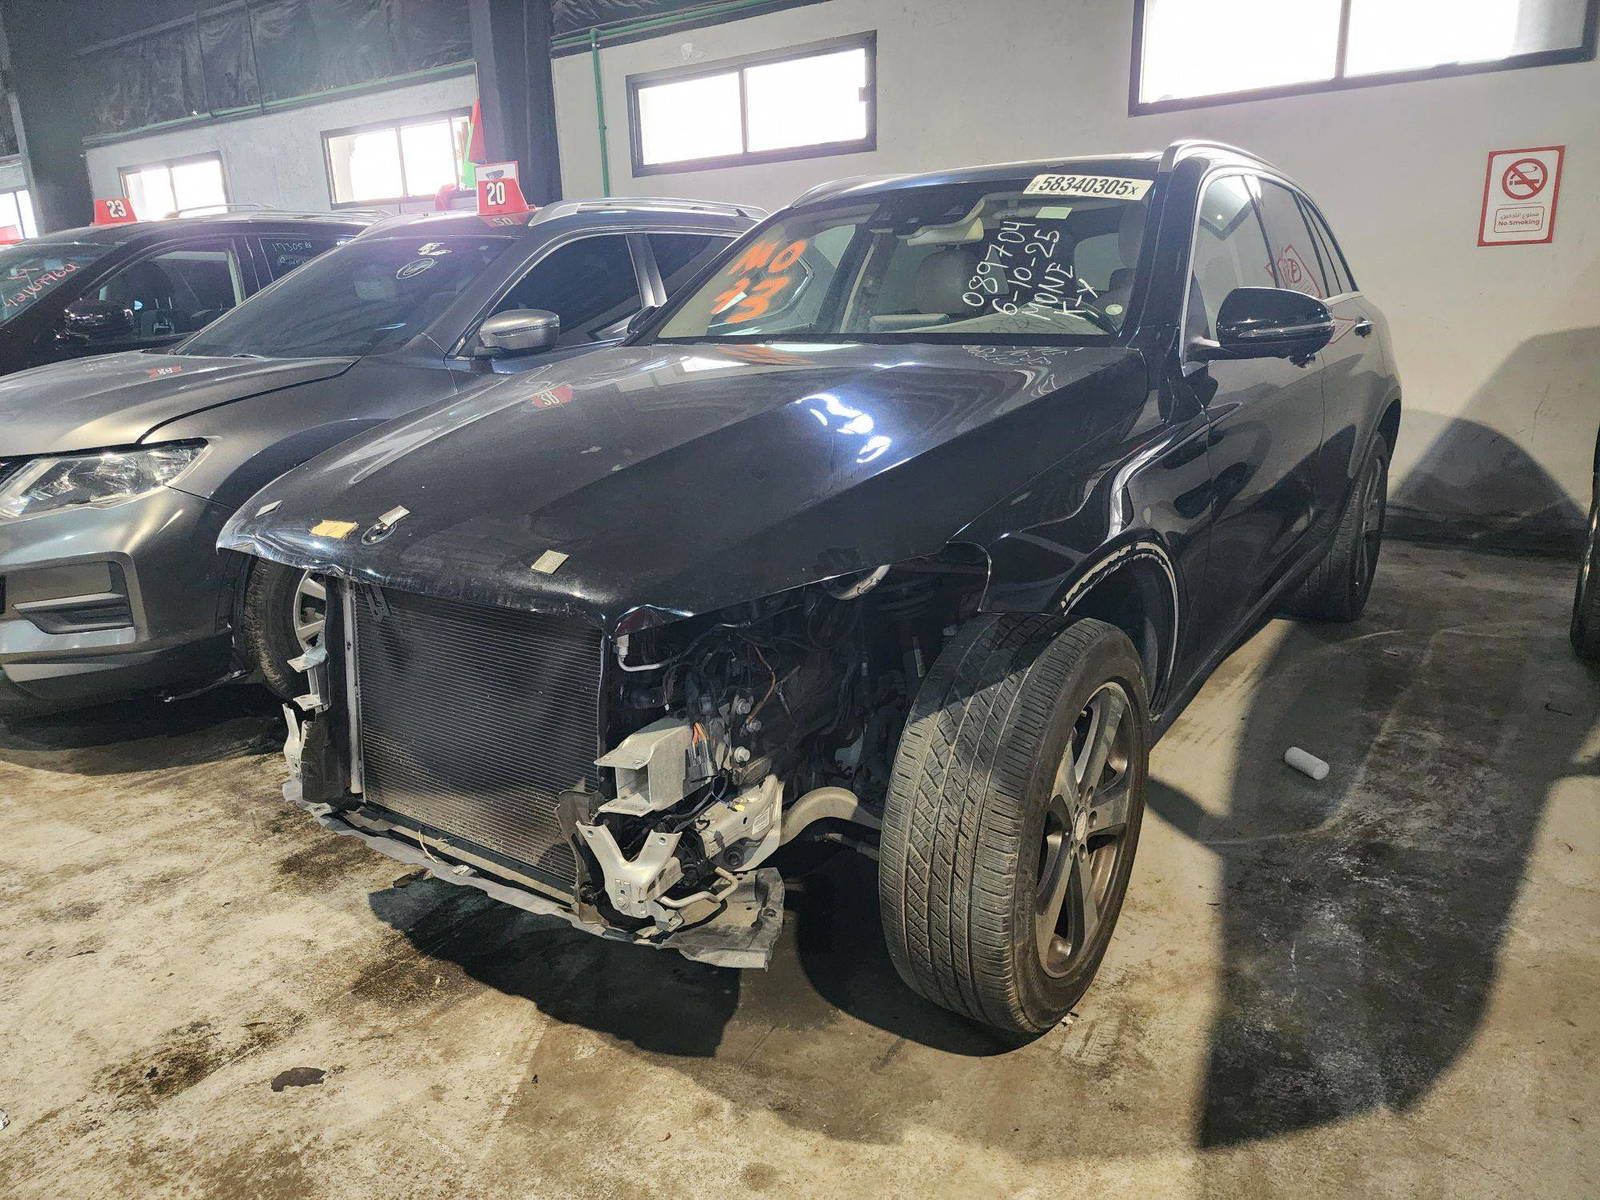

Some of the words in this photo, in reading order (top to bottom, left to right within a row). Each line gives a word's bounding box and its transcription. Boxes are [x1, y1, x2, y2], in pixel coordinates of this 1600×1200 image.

[105, 199, 128, 218] 23
[486, 181, 506, 206] 20
[727, 239, 806, 275] MO
[962, 221, 1036, 307] 089704
